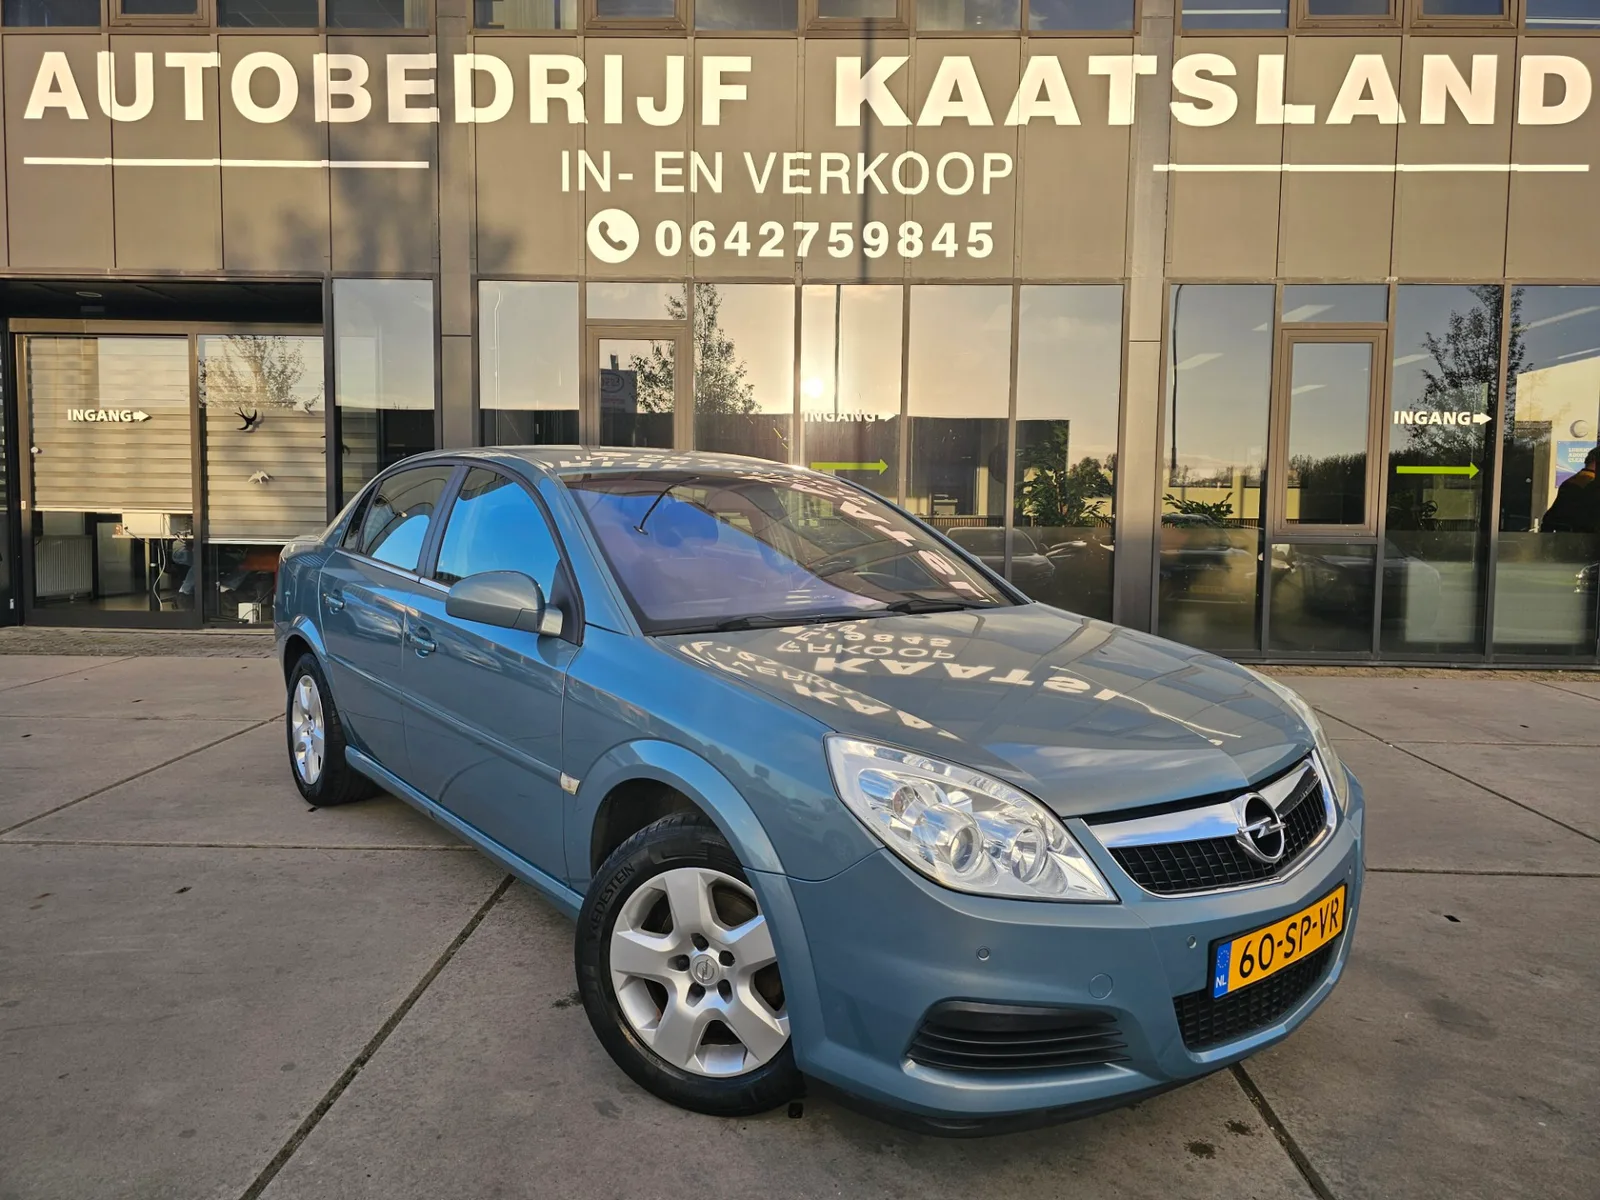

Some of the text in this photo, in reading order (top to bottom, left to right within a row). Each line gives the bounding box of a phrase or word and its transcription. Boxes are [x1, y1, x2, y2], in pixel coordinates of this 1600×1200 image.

[23, 50, 1592, 127] AUTOBEDRIJF KAATSLAND
[561, 149, 1013, 196] IN- EN VERKOOP
[655, 220, 994, 259] 0642759845
[67, 408, 132, 423] INGANG
[804, 410, 876, 423] INGANG
[1393, 410, 1471, 426] INGANG
[1239, 896, 1340, 979] 60-SP-VR
[1215, 973, 1227, 989] NL
